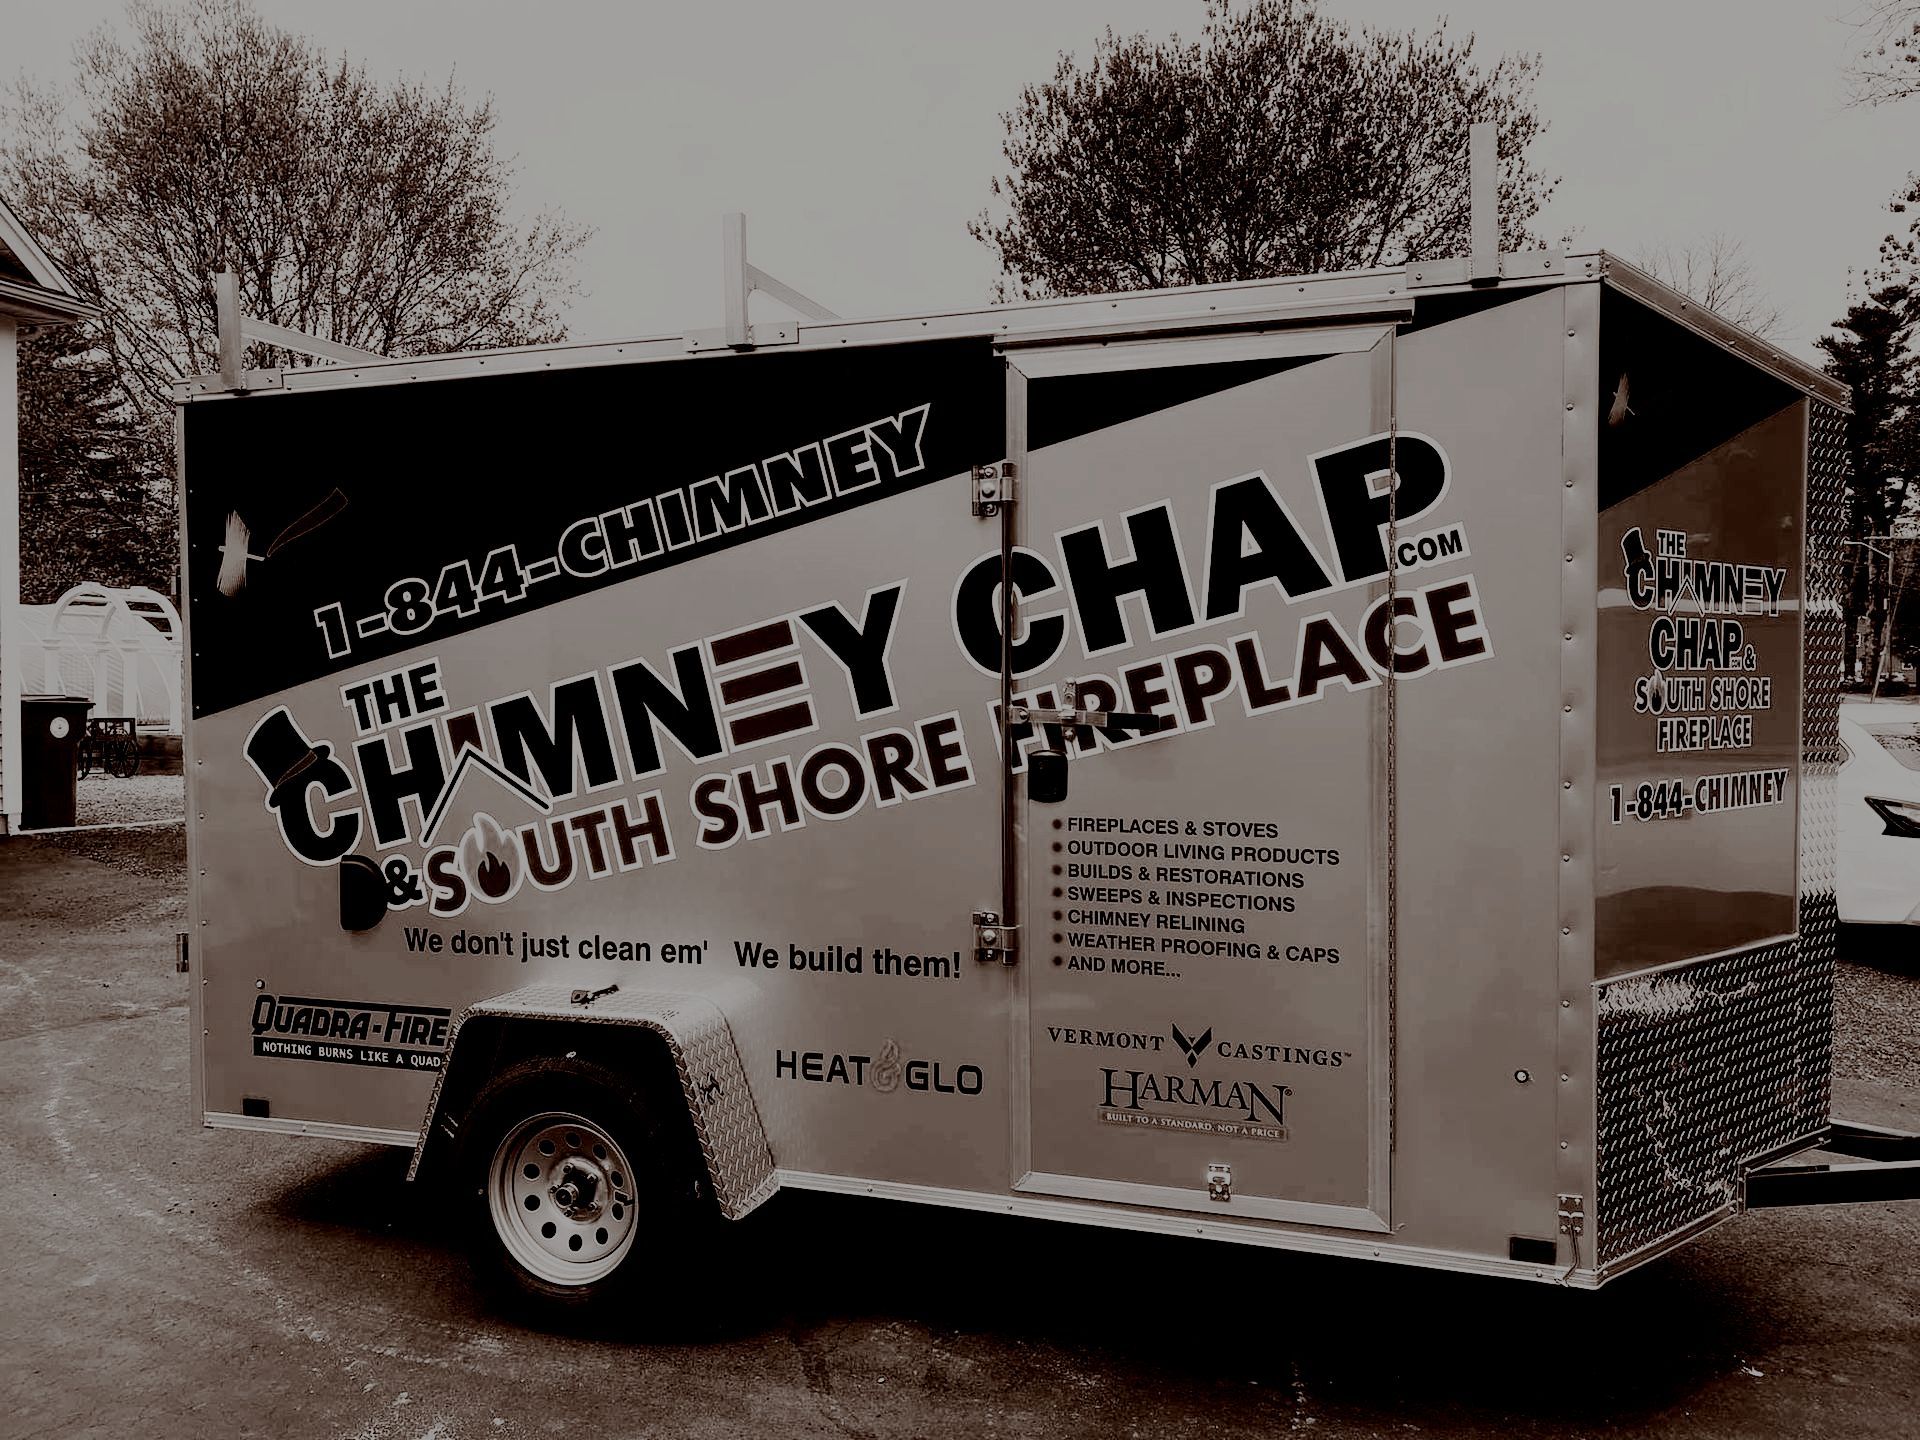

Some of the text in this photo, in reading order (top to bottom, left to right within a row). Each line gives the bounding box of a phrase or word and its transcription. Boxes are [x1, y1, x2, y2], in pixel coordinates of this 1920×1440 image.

[313, 403, 931, 659] 1-844-CHIMNEY
[1656, 529, 1686, 556] THE
[1626, 557, 1786, 616] CHIMNEY
[277, 580, 908, 864] CHIMNEY
[954, 434, 1449, 677] CHAP
[1650, 616, 1756, 670] CHAP &
[342, 658, 446, 734] THE
[1634, 676, 1770, 714] SOUTH SHORE
[384, 577, 1490, 914] & SOUTH SHORE FIREPLACE
[1657, 716, 1752, 752] FIREPLACE
[1609, 769, 1788, 824] 1-844-CHIMNEY
[1068, 817, 1278, 838] FIREPLACES & STOVES
[1068, 840, 1340, 865] OUTDOOR LIVING PRODUCTS
[1068, 863, 1304, 888] BUILDS & RESTORATIONS
[1068, 887, 1295, 912] SWEEPS & INSPECTIONS
[1068, 910, 1245, 933] CHIMNEY RELINING
[404, 927, 708, 964] We don't just clean em'
[735, 941, 962, 978] We build them!
[1068, 933, 1340, 963] WEATHER PROOFING & CAPS
[1068, 956, 1181, 977] AND MORE...
[252, 994, 449, 1046] QUADRA-FIRE
[263, 1041, 312, 1056] NOTHING
[318, 1046, 353, 1060] BURNS
[360, 1050, 389, 1063] LIKE
[396, 1054, 404, 1065] A
[1048, 1026, 1165, 1052] VERMONT
[776, 1049, 870, 1086] HEAT
[905, 1060, 983, 1095] GLO
[1106, 1112, 1133, 1123] BUILT
[1135, 1114, 1149, 1124] TO
[1217, 1124, 1240, 1133] NOT
[1250, 1127, 1281, 1138] PRICE
